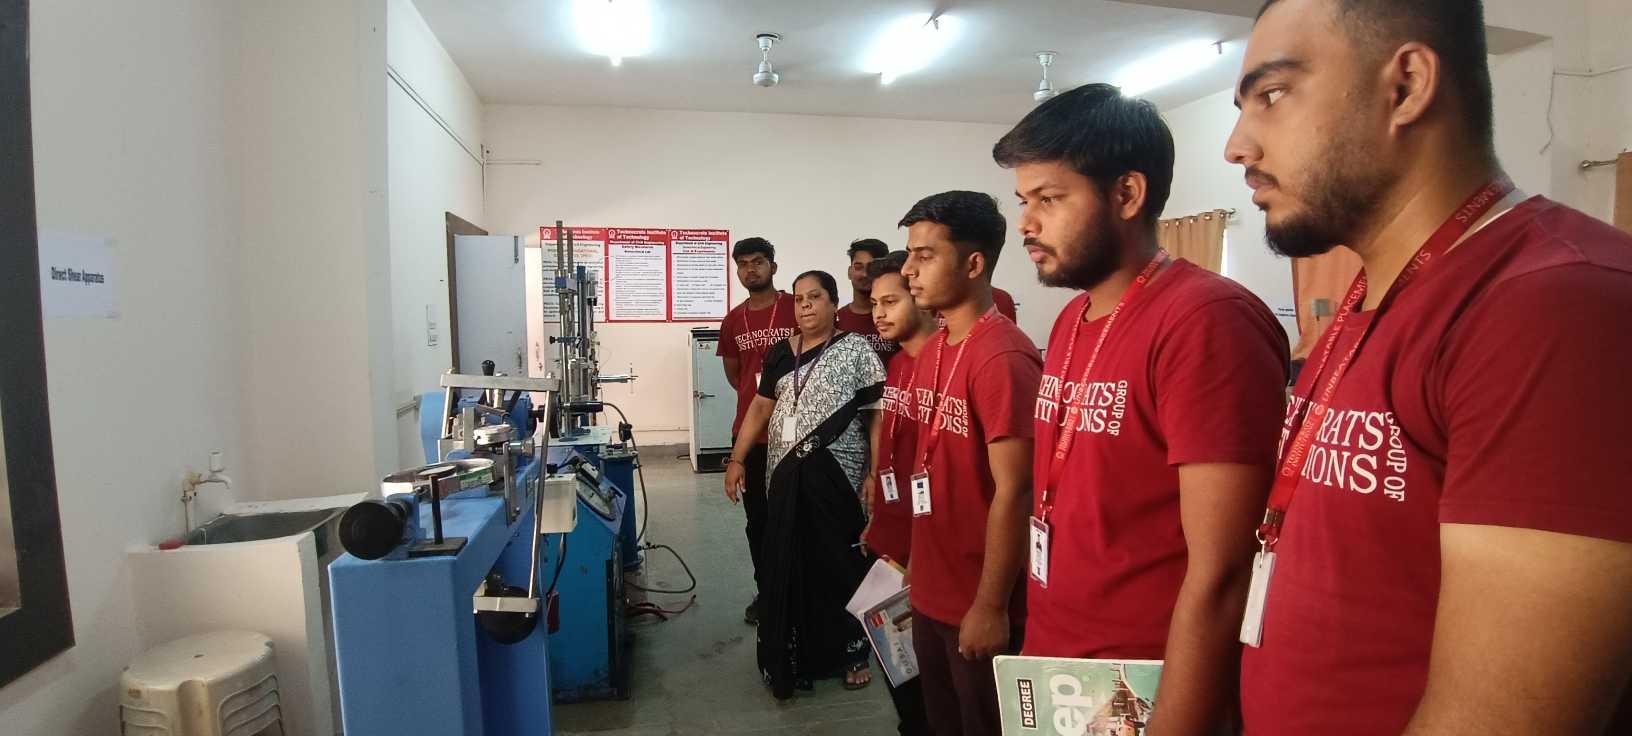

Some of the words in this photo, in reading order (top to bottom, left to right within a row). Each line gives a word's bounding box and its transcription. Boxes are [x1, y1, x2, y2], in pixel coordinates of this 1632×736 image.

[51, 266, 66, 280] Direct
[67, 267, 81, 282] Shear
[81, 269, 105, 285] Apparatus
[1112, 380, 1128, 420] GROUP
[1106, 420, 1121, 437] OF
[1385, 411, 1407, 474] GROUP
[1383, 476, 1406, 502] OF
[1020, 680, 1036, 727] DEGREE
